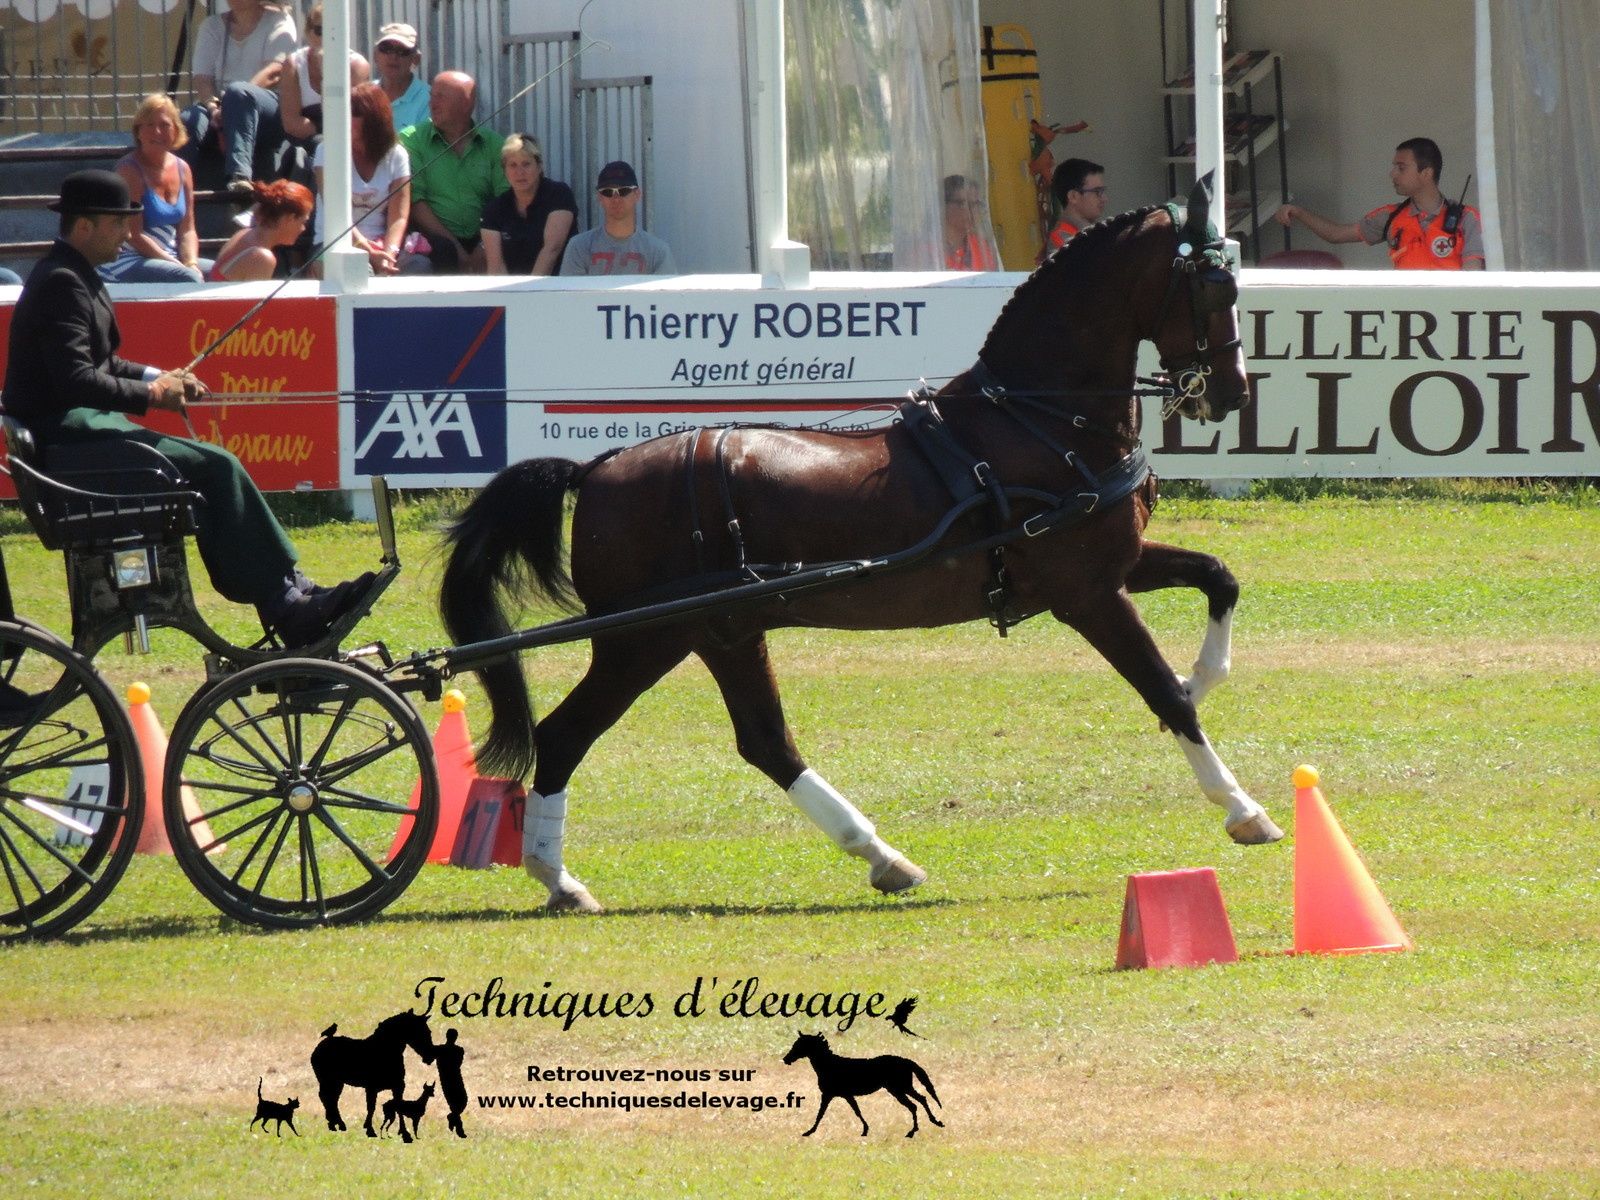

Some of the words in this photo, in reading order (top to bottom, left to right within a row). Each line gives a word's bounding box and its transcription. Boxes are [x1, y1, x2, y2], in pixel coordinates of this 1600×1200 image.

[190, 319, 315, 360] Camions
[597, 304, 739, 349] Thierry
[754, 301, 926, 339] ROBERT
[1238, 310, 1525, 361] LLERIE
[670, 358, 750, 386] Agent
[756, 356, 855, 384] général
[220, 371, 288, 421] pour
[355, 393, 483, 459] AXA
[540, 422, 561, 439] 10
[568, 426, 599, 439] rue
[605, 421, 628, 439] de
[635, 421, 652, 438] la
[461, 800, 500, 863] 17
